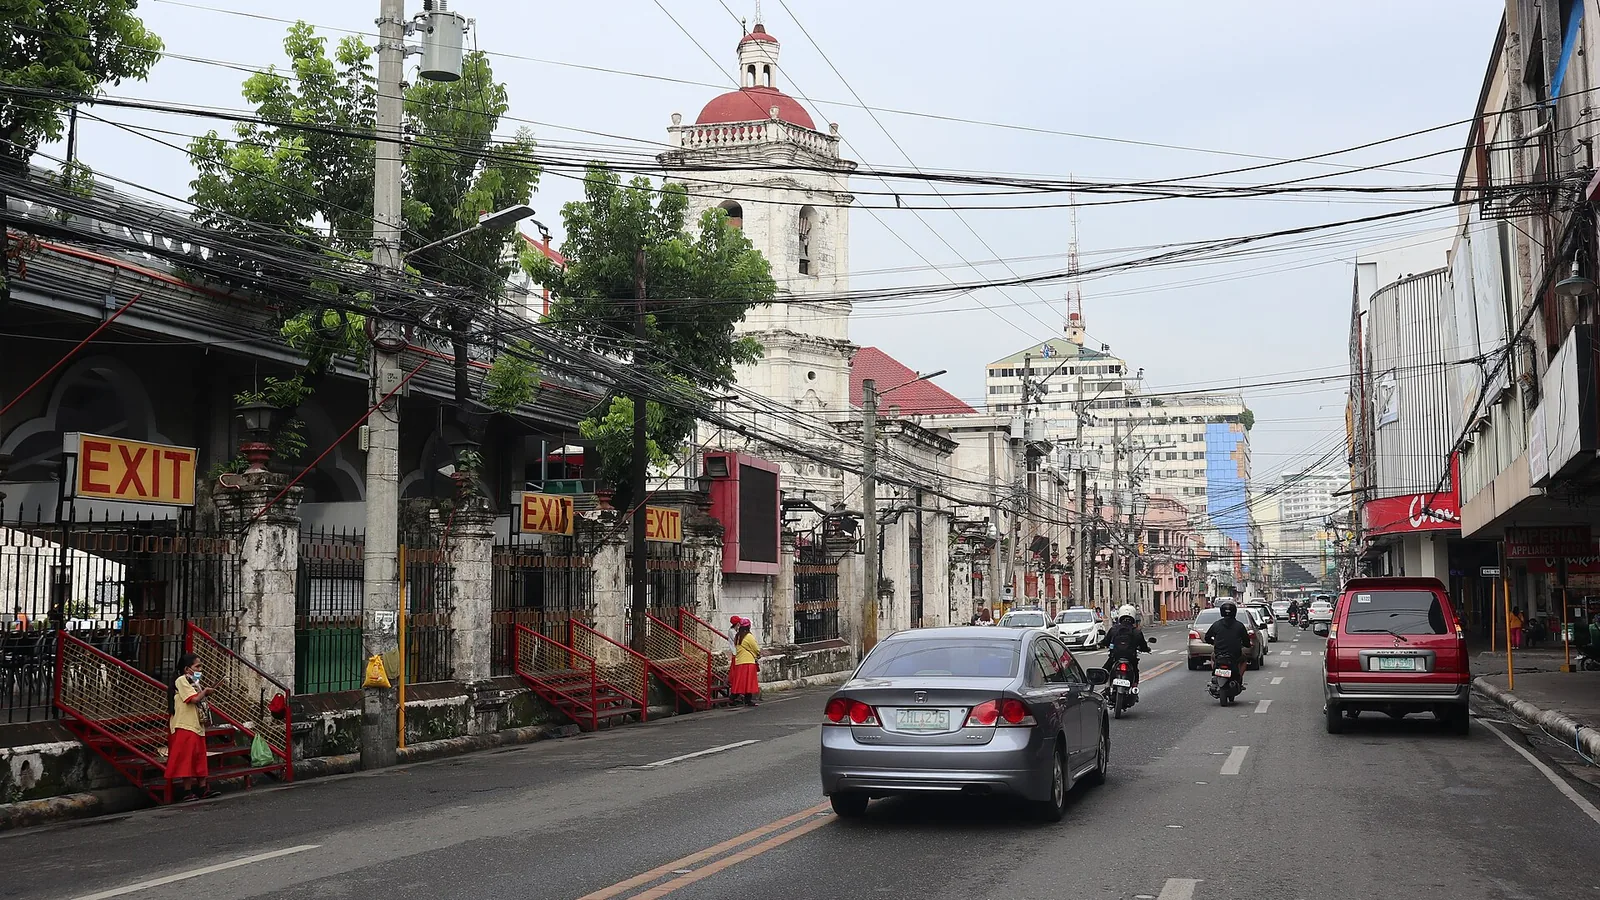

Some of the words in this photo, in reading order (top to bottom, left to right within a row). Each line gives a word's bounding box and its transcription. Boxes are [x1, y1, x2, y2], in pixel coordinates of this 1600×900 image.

[81, 440, 190, 499] EXIT
[646, 508, 679, 539] EXIT
[1509, 528, 1587, 544] IMPERIAL
[1511, 544, 1556, 556] APPLIANCE
[1560, 543, 1588, 555] PLAZA
[899, 712, 920, 723] ZHL
[925, 712, 946, 724] 275
